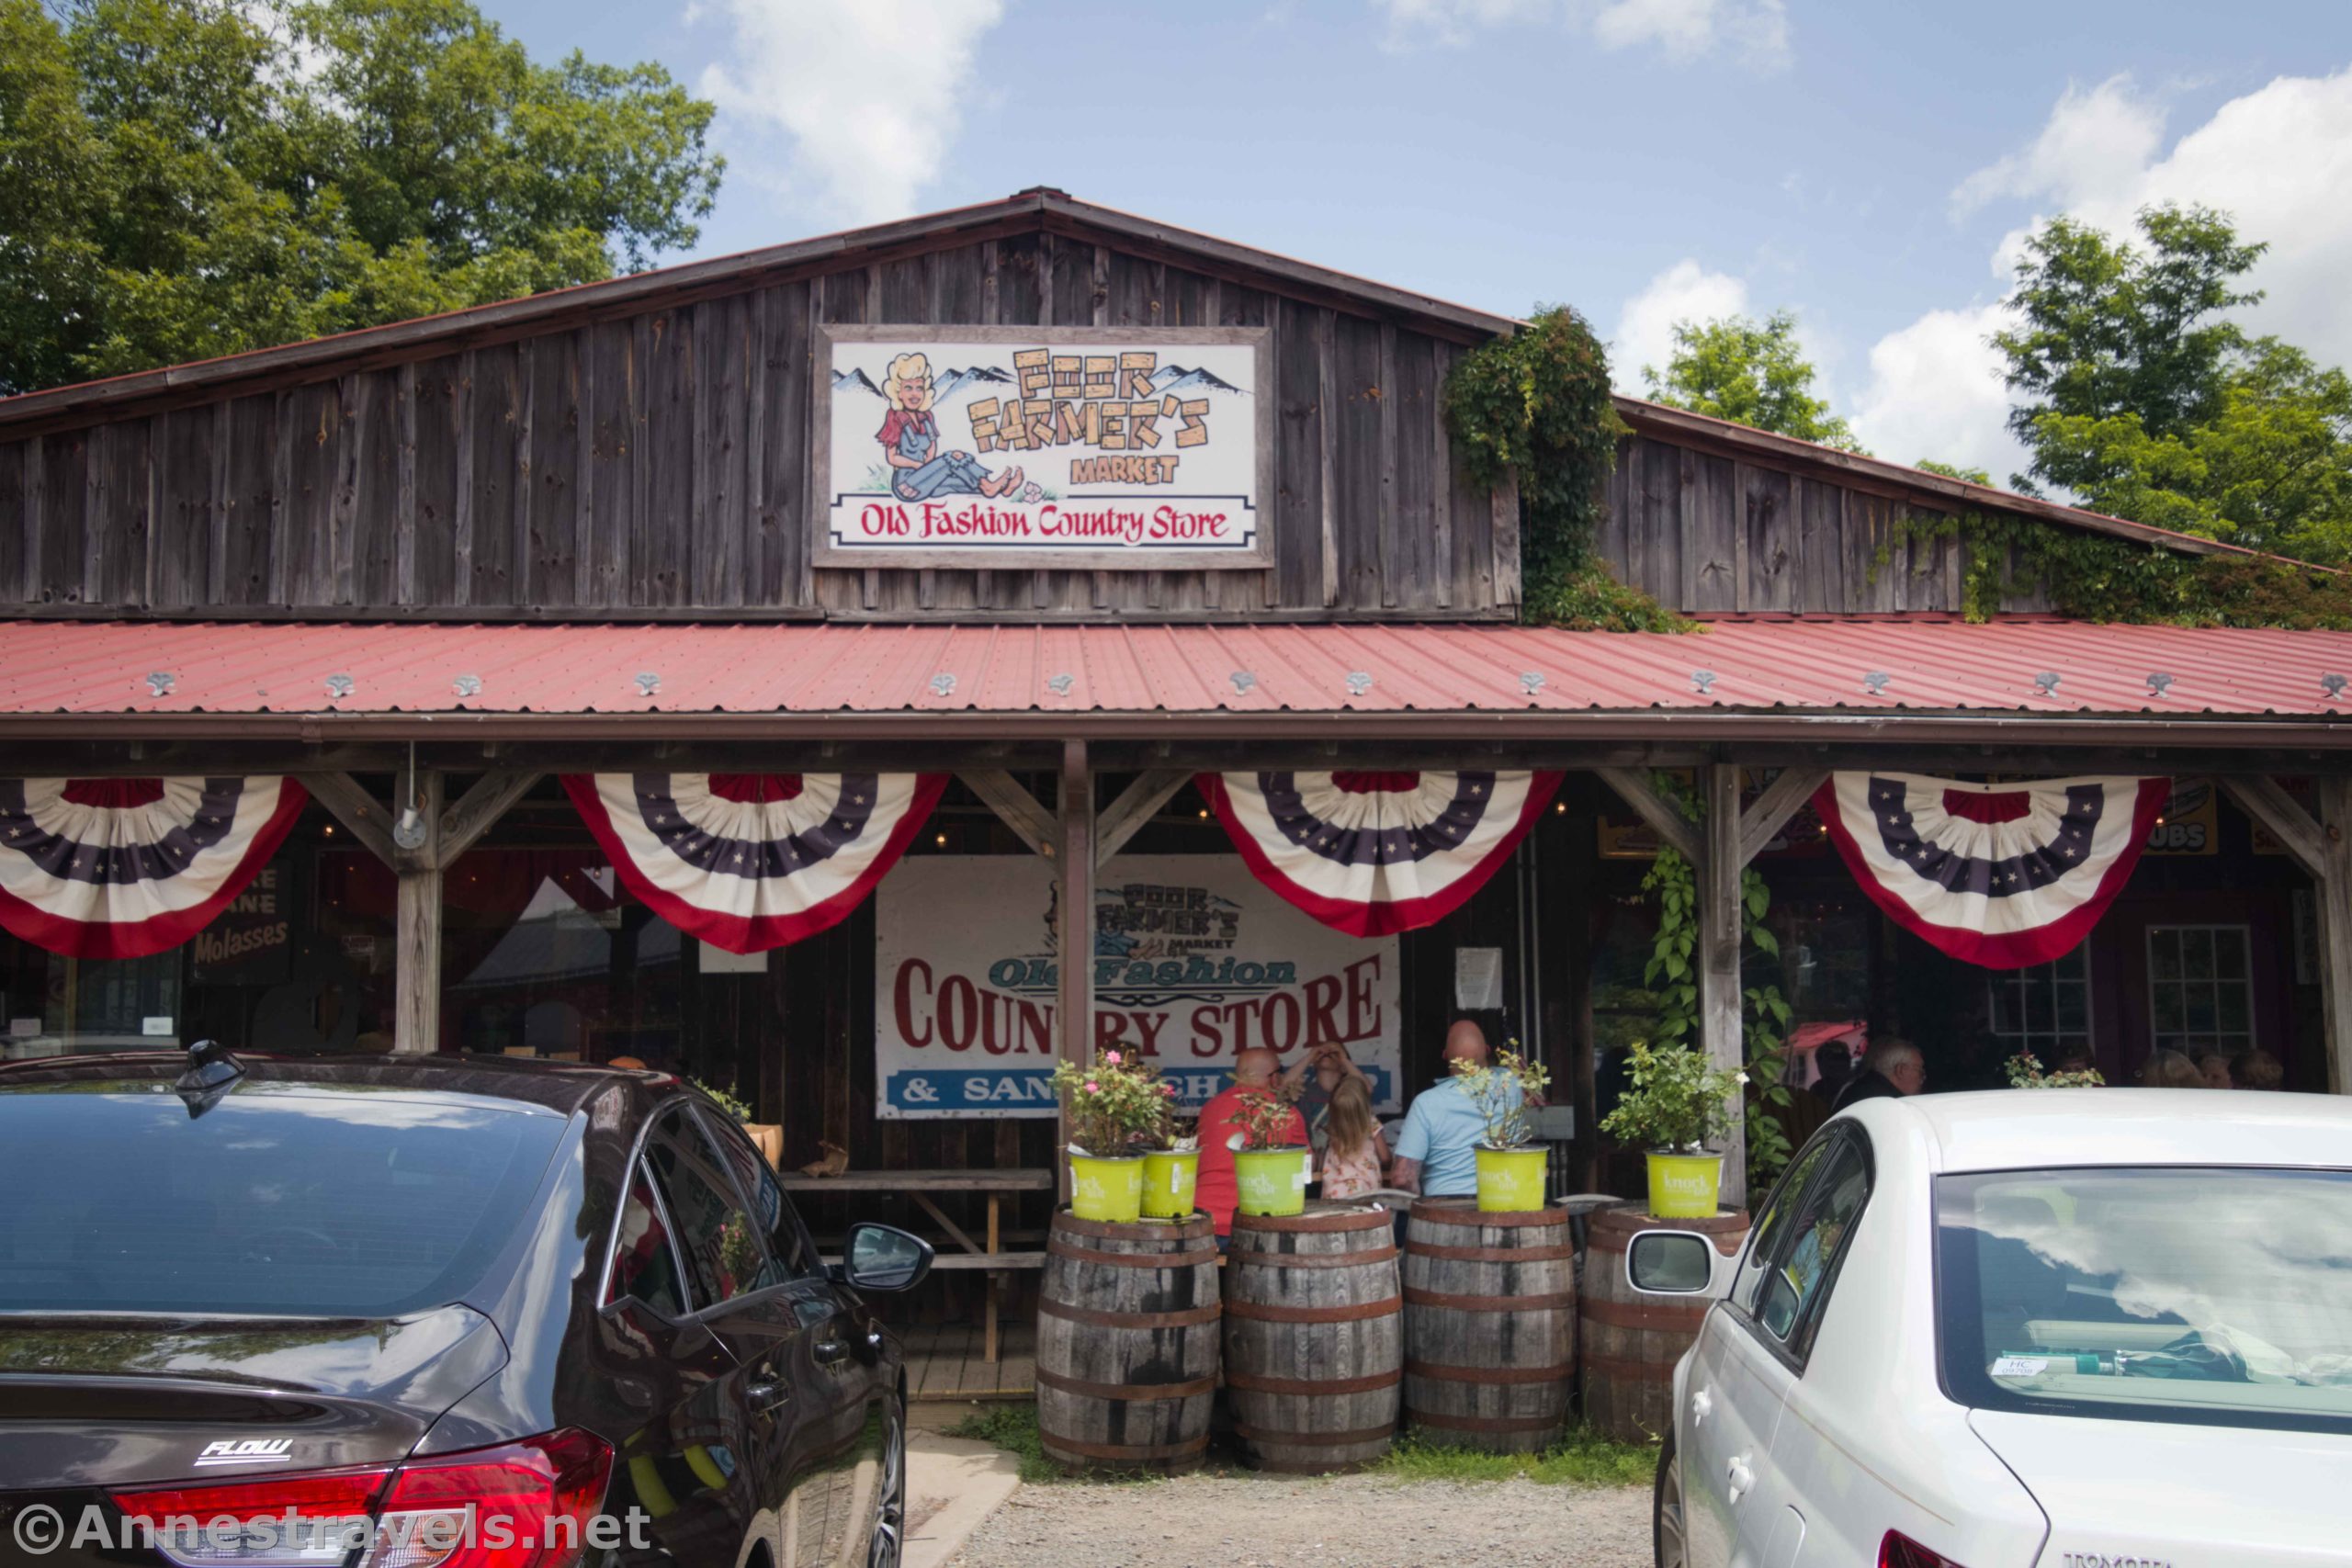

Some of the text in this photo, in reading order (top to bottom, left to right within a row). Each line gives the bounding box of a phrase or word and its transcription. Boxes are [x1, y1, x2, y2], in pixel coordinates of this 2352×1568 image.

[1013, 348, 1157, 399] POOR
[967, 394, 1209, 453] FARMER'S
[1070, 456, 1179, 484] MARKET
[861, 502, 1229, 542] Old Fashion Country Store
[194, 921, 288, 964] Molasses
[1170, 939, 1236, 950] MARKET
[1095, 955, 1296, 986] Fashion
[894, 957, 1170, 1056] COUNRY
[1191, 953, 1382, 1058] STORE
[902, 1077, 940, 1102] &
[200, 1438, 294, 1457] FLOW
